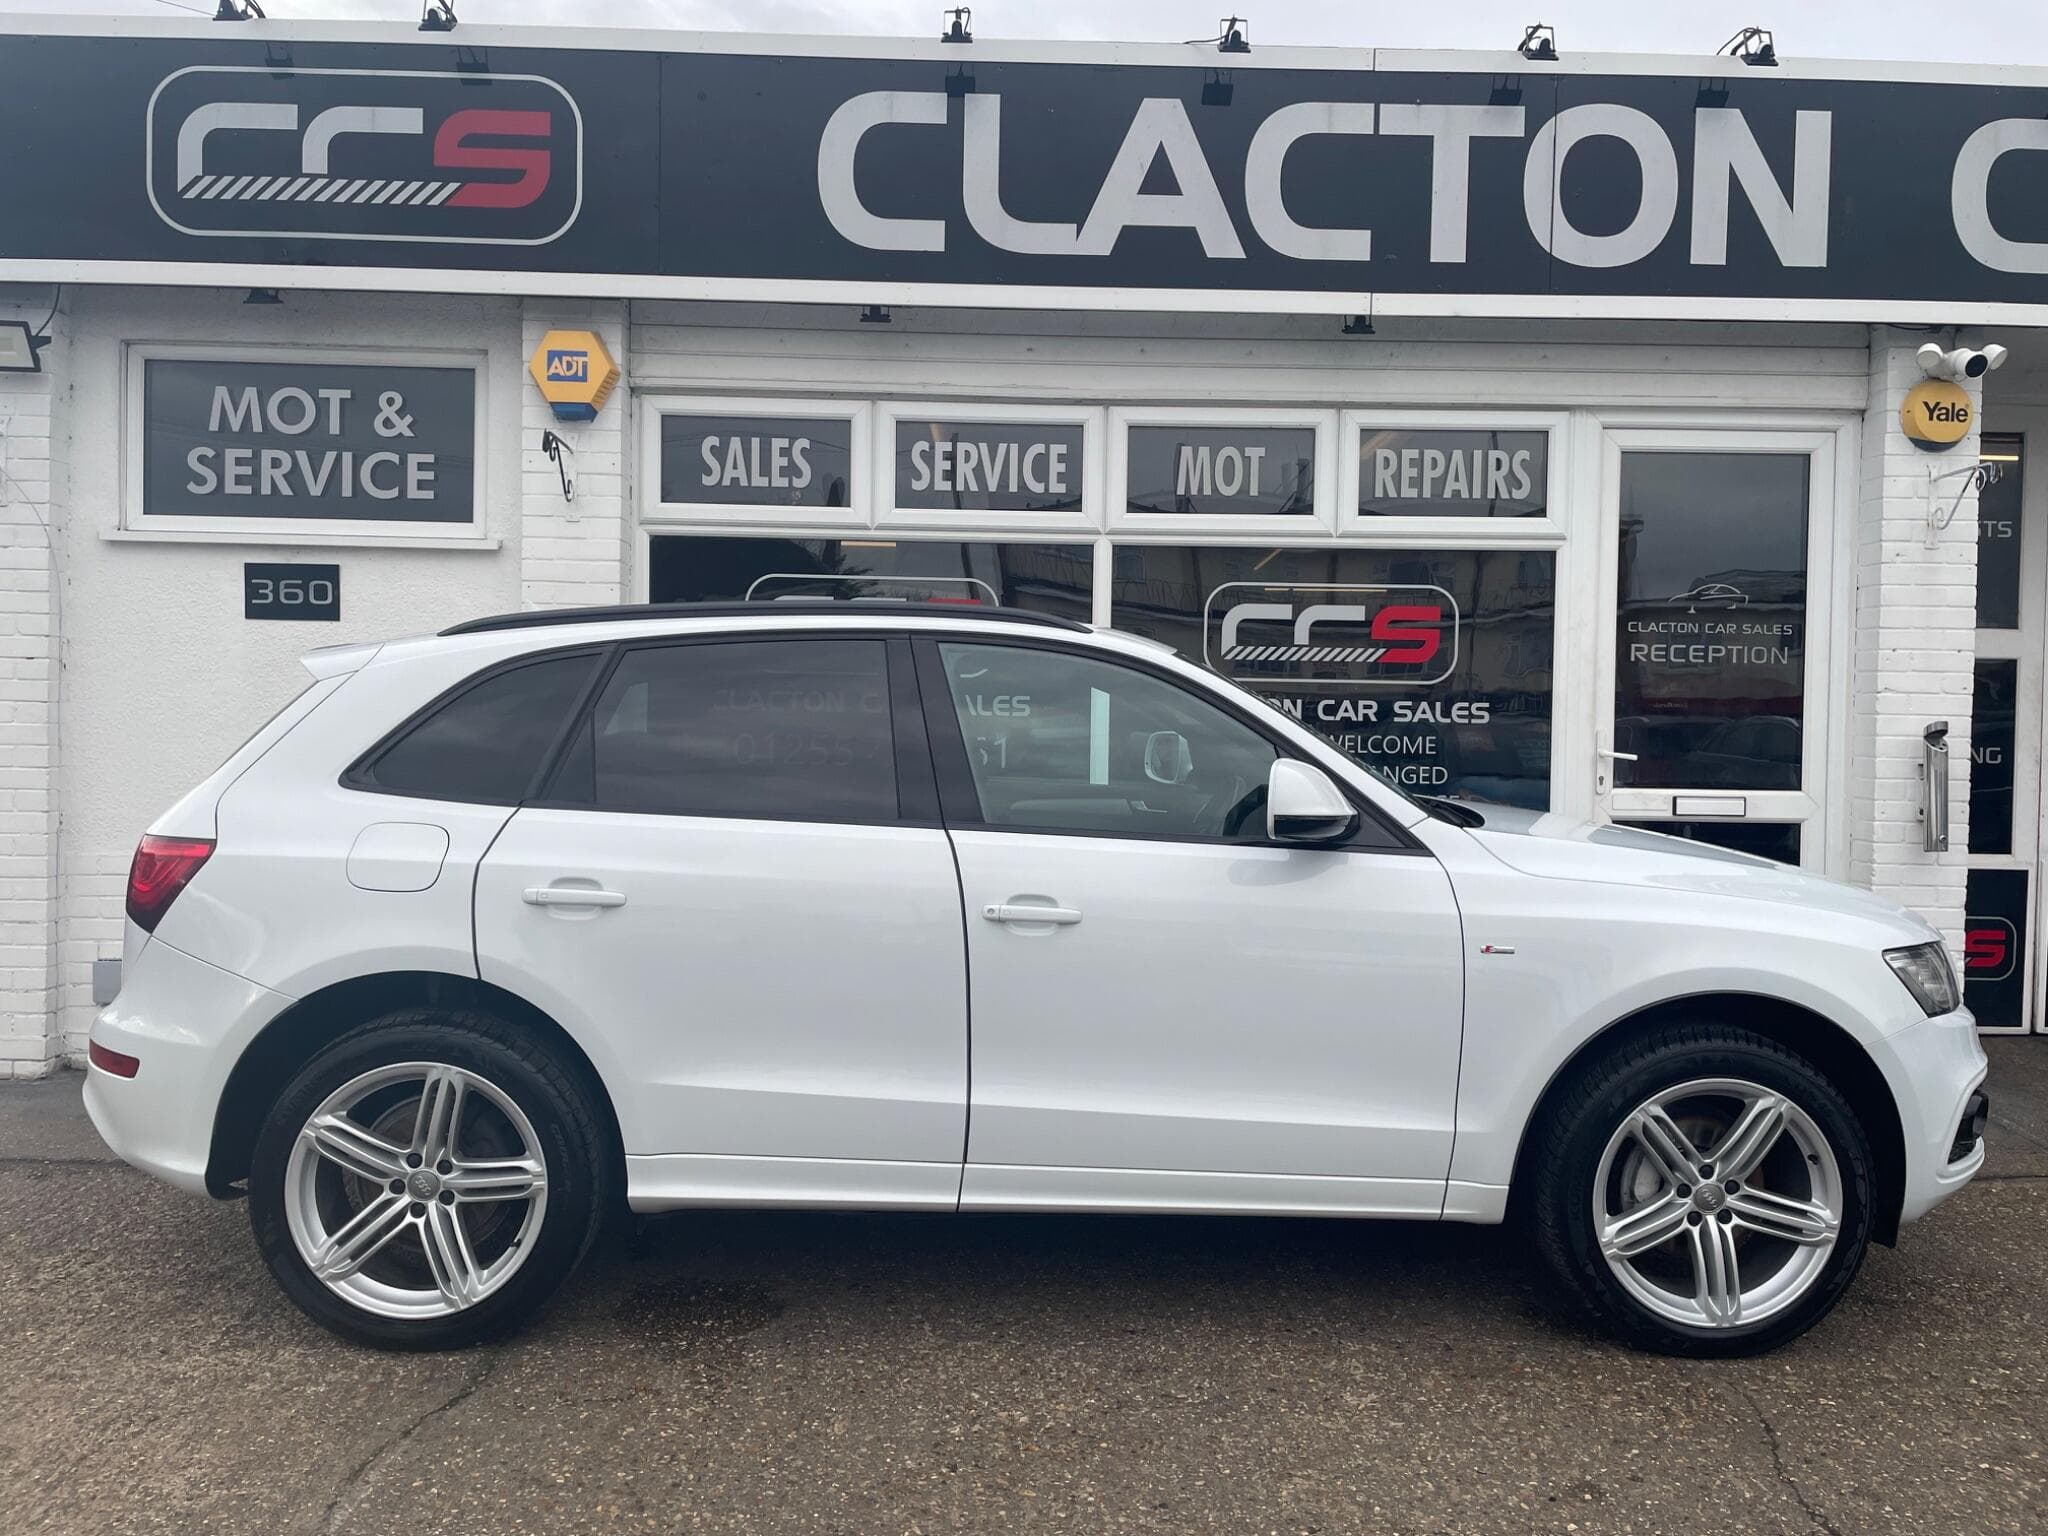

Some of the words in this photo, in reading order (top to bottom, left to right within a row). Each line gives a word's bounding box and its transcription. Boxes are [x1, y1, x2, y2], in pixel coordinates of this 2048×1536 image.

[817, 90, 1832, 269] CLACTON
[547, 352, 588, 378] ADT
[208, 386, 351, 435] MOT
[373, 391, 414, 437] &
[1922, 400, 1968, 423] Yale
[186, 447, 435, 500] SERVICE
[701, 436, 812, 489] SALES
[910, 440, 1068, 494] SERVICE
[1176, 445, 1266, 498] MOT
[1374, 448, 1531, 500] REPAIRS
[251, 578, 333, 605] 360
[1628, 621, 1700, 634] CLACTON
[1705, 623, 1736, 635] CAR
[1742, 624, 1793, 636] SALES
[1630, 643, 1789, 665] RECEPTION
[1317, 699, 1378, 722] CAR
[1393, 701, 1490, 724] SALES
